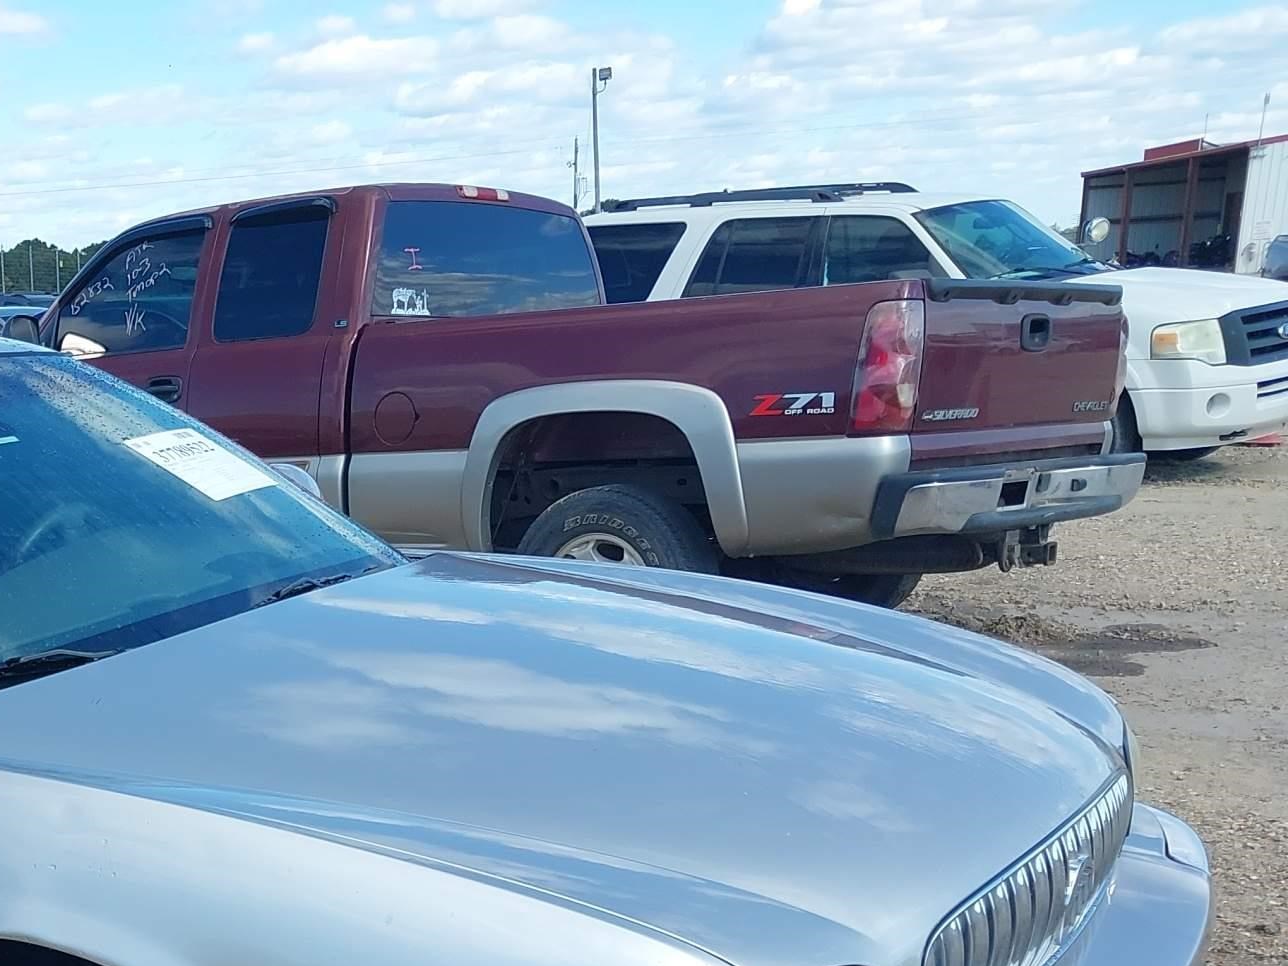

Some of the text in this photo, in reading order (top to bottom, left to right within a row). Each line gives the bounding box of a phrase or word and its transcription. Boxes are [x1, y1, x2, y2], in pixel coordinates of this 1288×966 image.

[748, 391, 835, 416] Z71
[1073, 401, 1109, 412] CHEVROLET
[931, 407, 980, 421] SILVERADO
